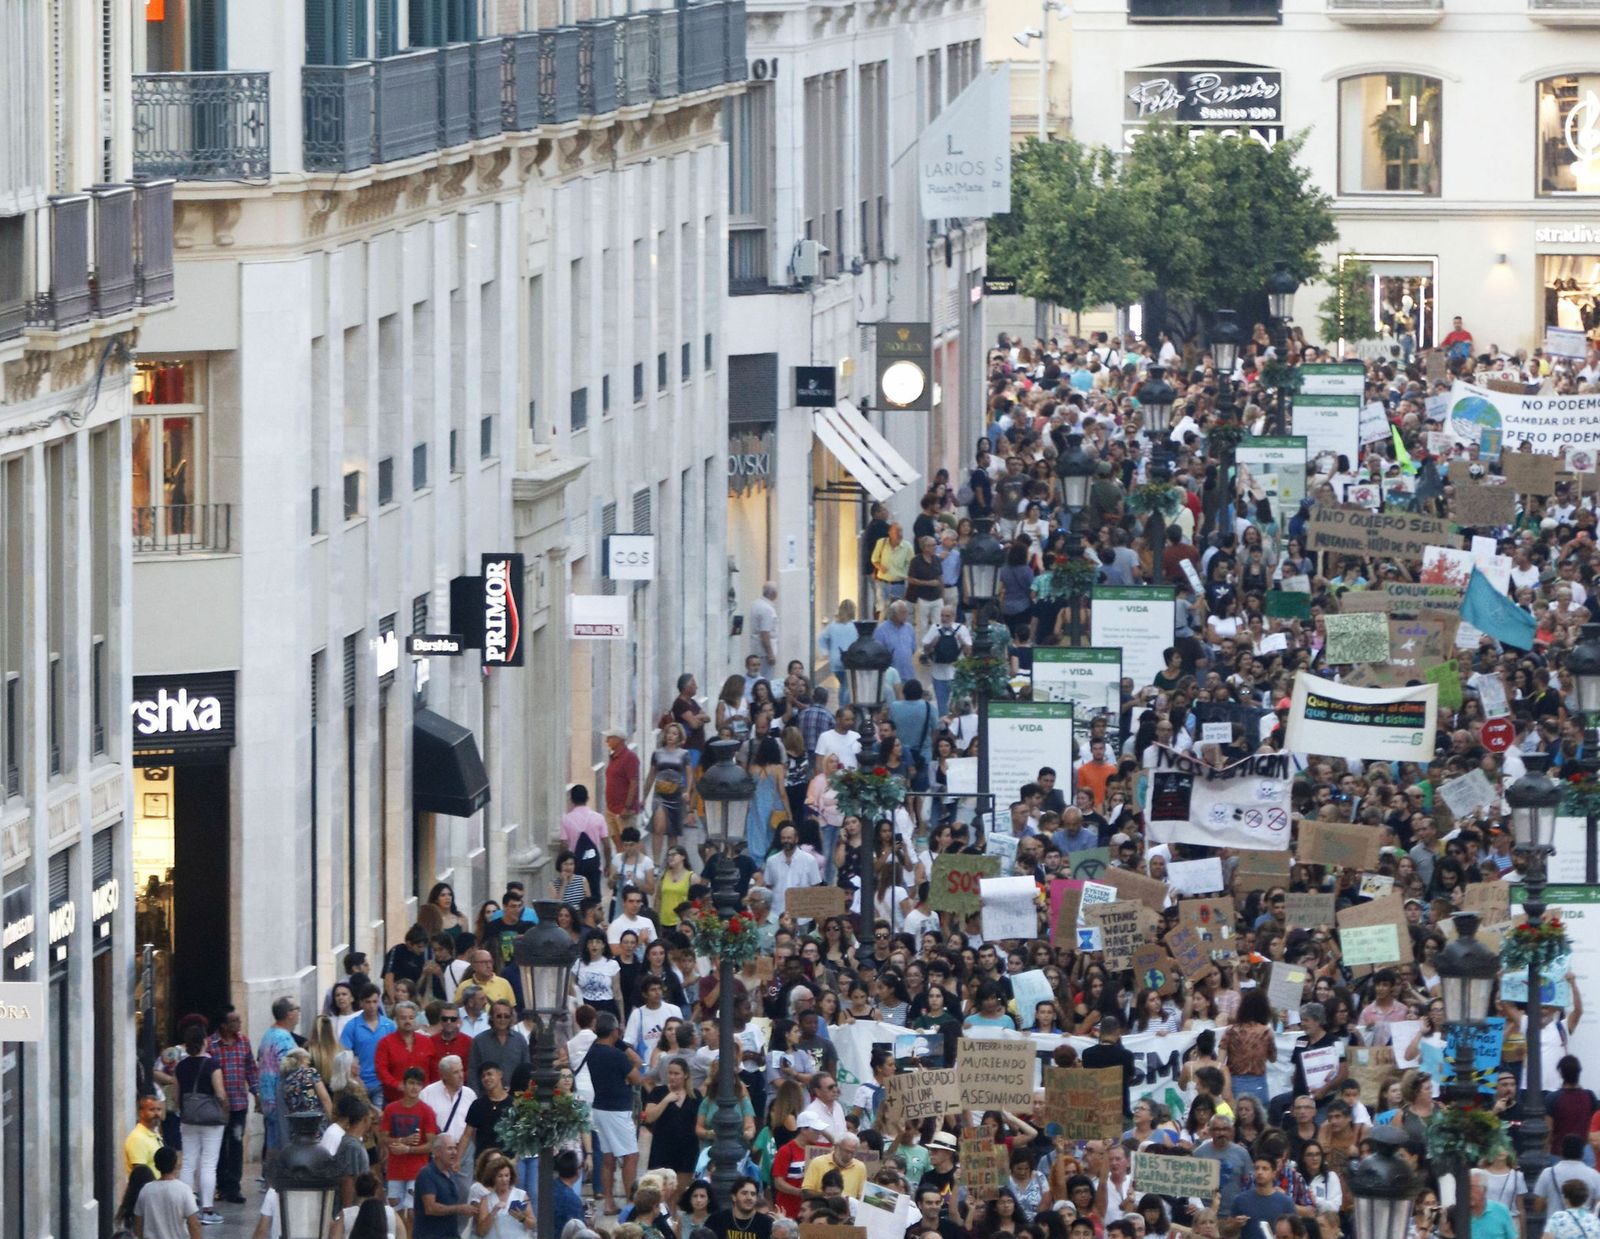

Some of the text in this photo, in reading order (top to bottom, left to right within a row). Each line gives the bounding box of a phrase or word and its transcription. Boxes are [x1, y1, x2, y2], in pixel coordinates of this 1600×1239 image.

[925, 160, 985, 178] LARIOS
[1522, 400, 1543, 411] NO
[1505, 415, 1558, 426] CAMBIAR
[1507, 430, 1547, 443] PERO
[1349, 514, 1405, 530] QUIERO
[614, 551, 649, 566] COS
[485, 559, 507, 662] PRIMOR
[413, 638, 459, 652] Bershka
[1308, 696, 1329, 708] Que
[1306, 708, 1327, 719] que
[1331, 712, 1371, 723] cambie
[1374, 714, 1384, 723] el
[1018, 724, 1043, 732] VIDA
[1085, 886, 1111, 897] SYSTEM
[1100, 910, 1138, 924] TITANIC
[1104, 923, 1137, 936] WOULD
[1104, 935, 1130, 948] HAVE
[962, 1058, 1027, 1070] MURIENDO
[888, 1070, 955, 1093] NI UN GRADO
[975, 1074, 1024, 1086] ESTAMOS
[901, 1087, 934, 1106] NI UNA
[960, 1089, 1031, 1105] ASESINANDO
